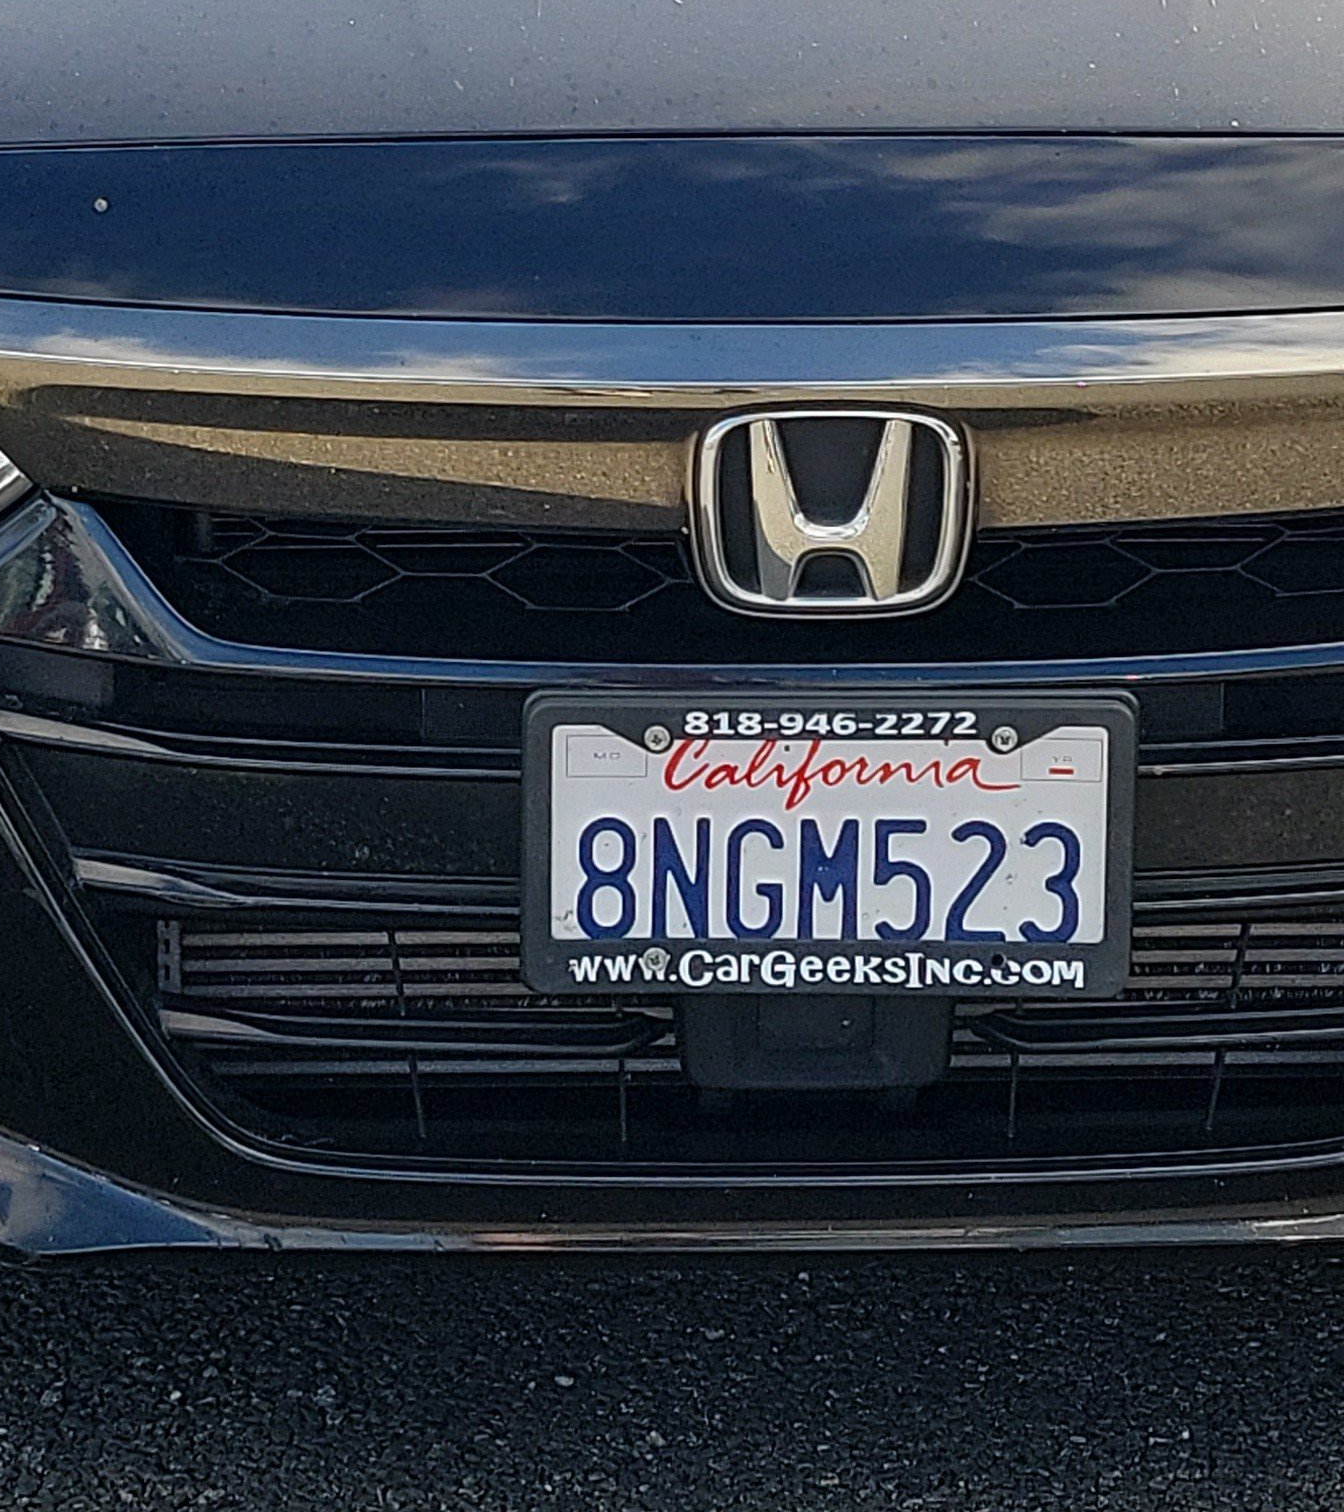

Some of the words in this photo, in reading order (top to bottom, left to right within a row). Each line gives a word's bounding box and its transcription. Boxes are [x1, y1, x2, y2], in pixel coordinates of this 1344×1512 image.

[683, 711, 979, 737] 818-946-2272
[663, 738, 1022, 810] California
[577, 817, 1081, 941] 8NGM523
